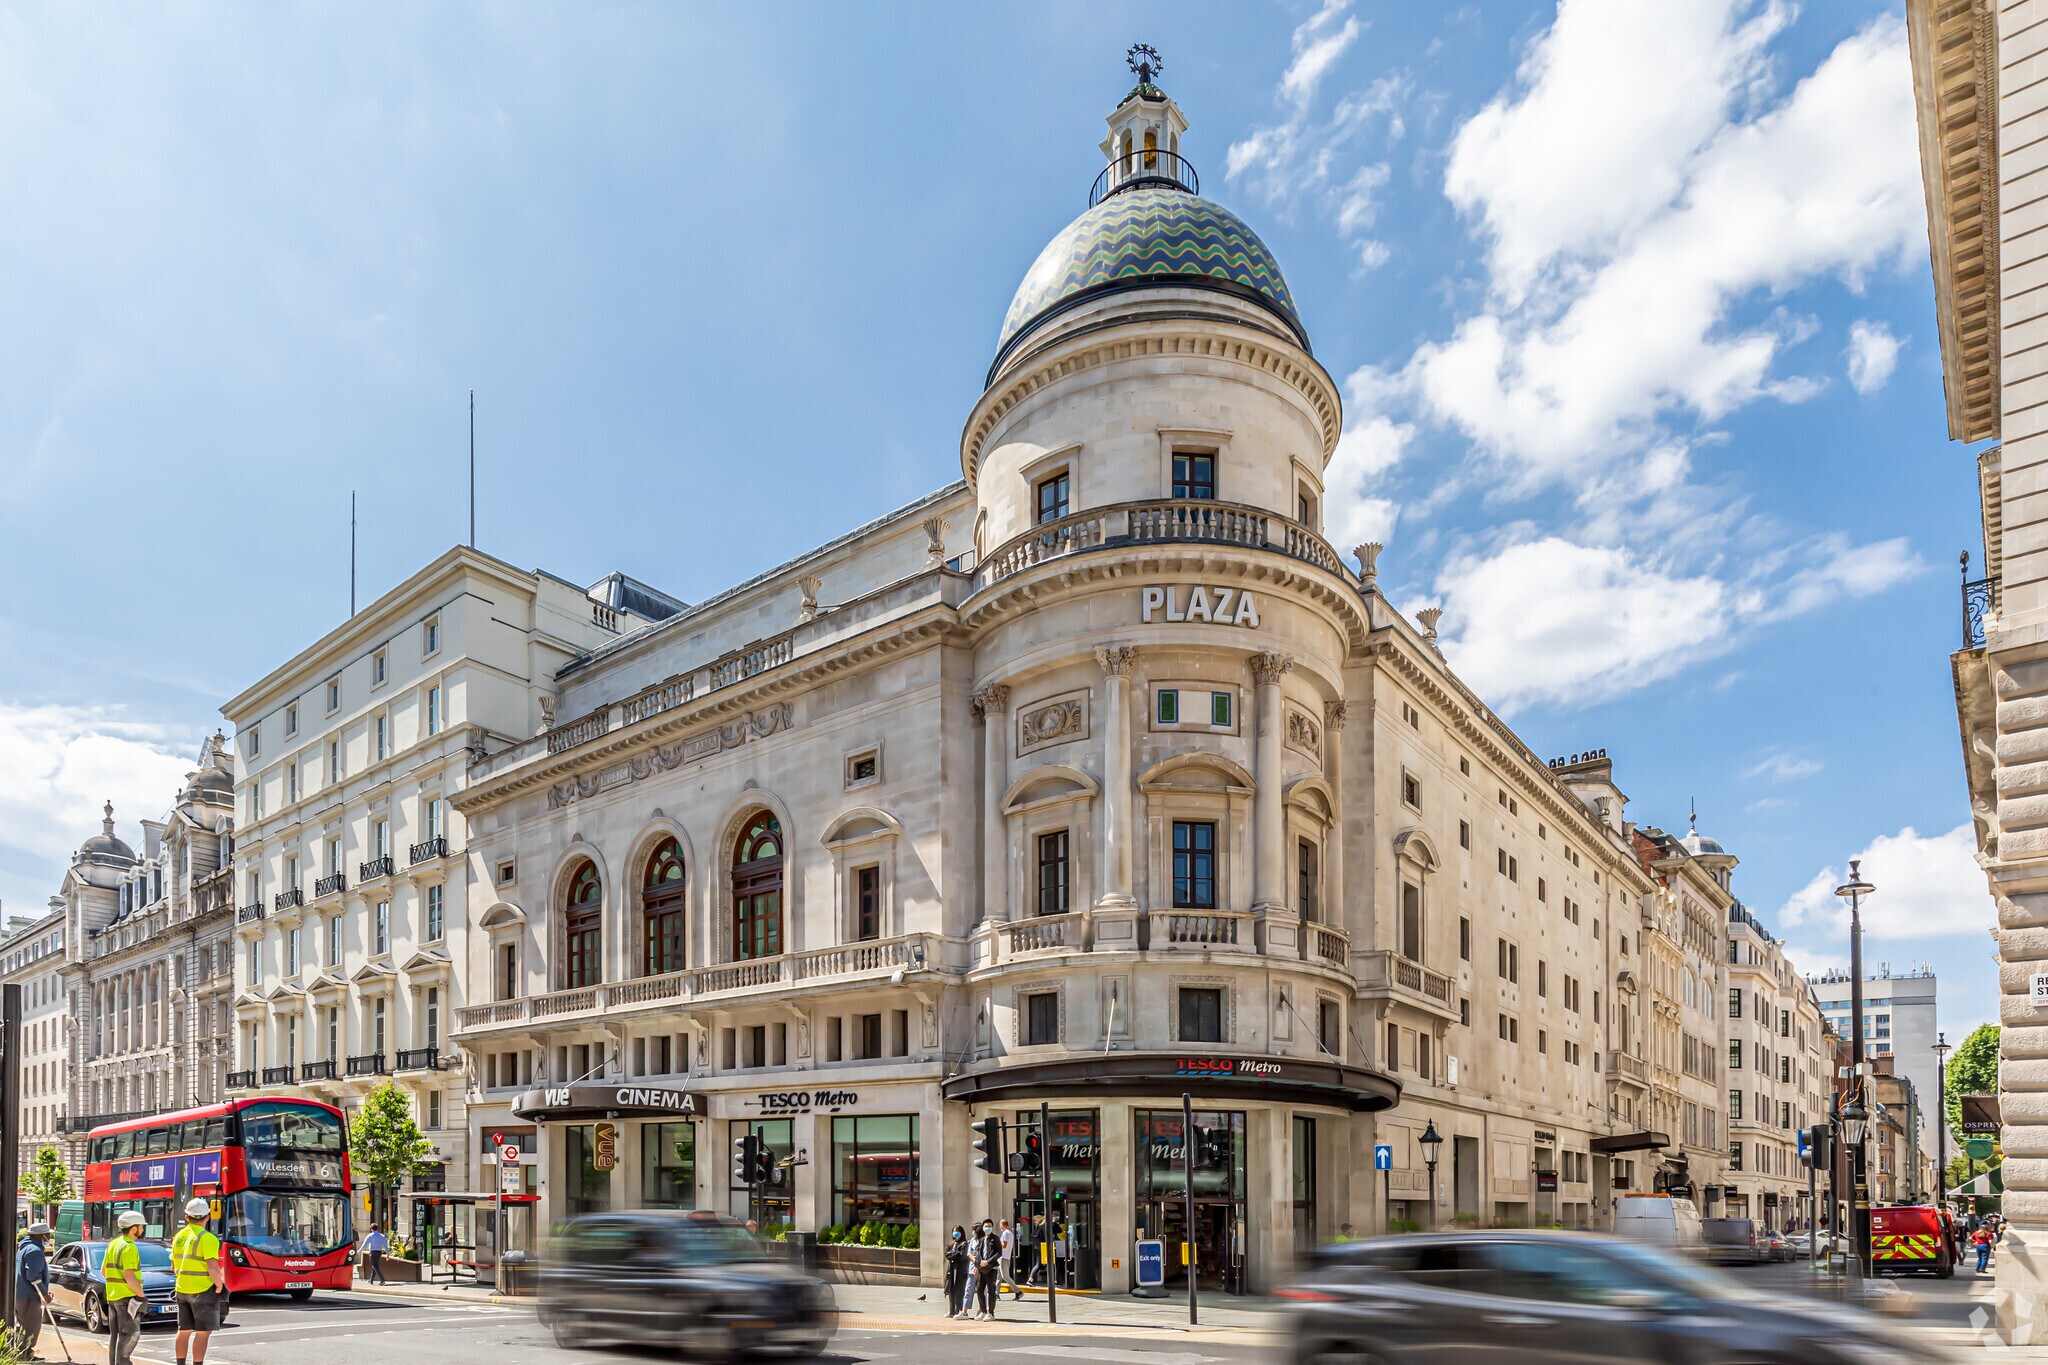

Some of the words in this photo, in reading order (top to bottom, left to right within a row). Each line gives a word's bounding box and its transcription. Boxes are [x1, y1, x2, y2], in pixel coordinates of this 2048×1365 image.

[1142, 586, 1260, 628] PLAZA
[1176, 1058, 1233, 1071] TESCO
[1240, 1060, 1281, 1073] Metro
[616, 1088, 696, 1112] CINEMA
[758, 1092, 810, 1108] TESCO
[814, 1090, 858, 1105] Metro
[1964, 1121, 2002, 1129] OSPREY
[254, 1161, 305, 1173] Willesden
[320, 1164, 330, 1178] 6
[1392, 1174, 1407, 1186] EXIT
[284, 1259, 316, 1267] Metroline
